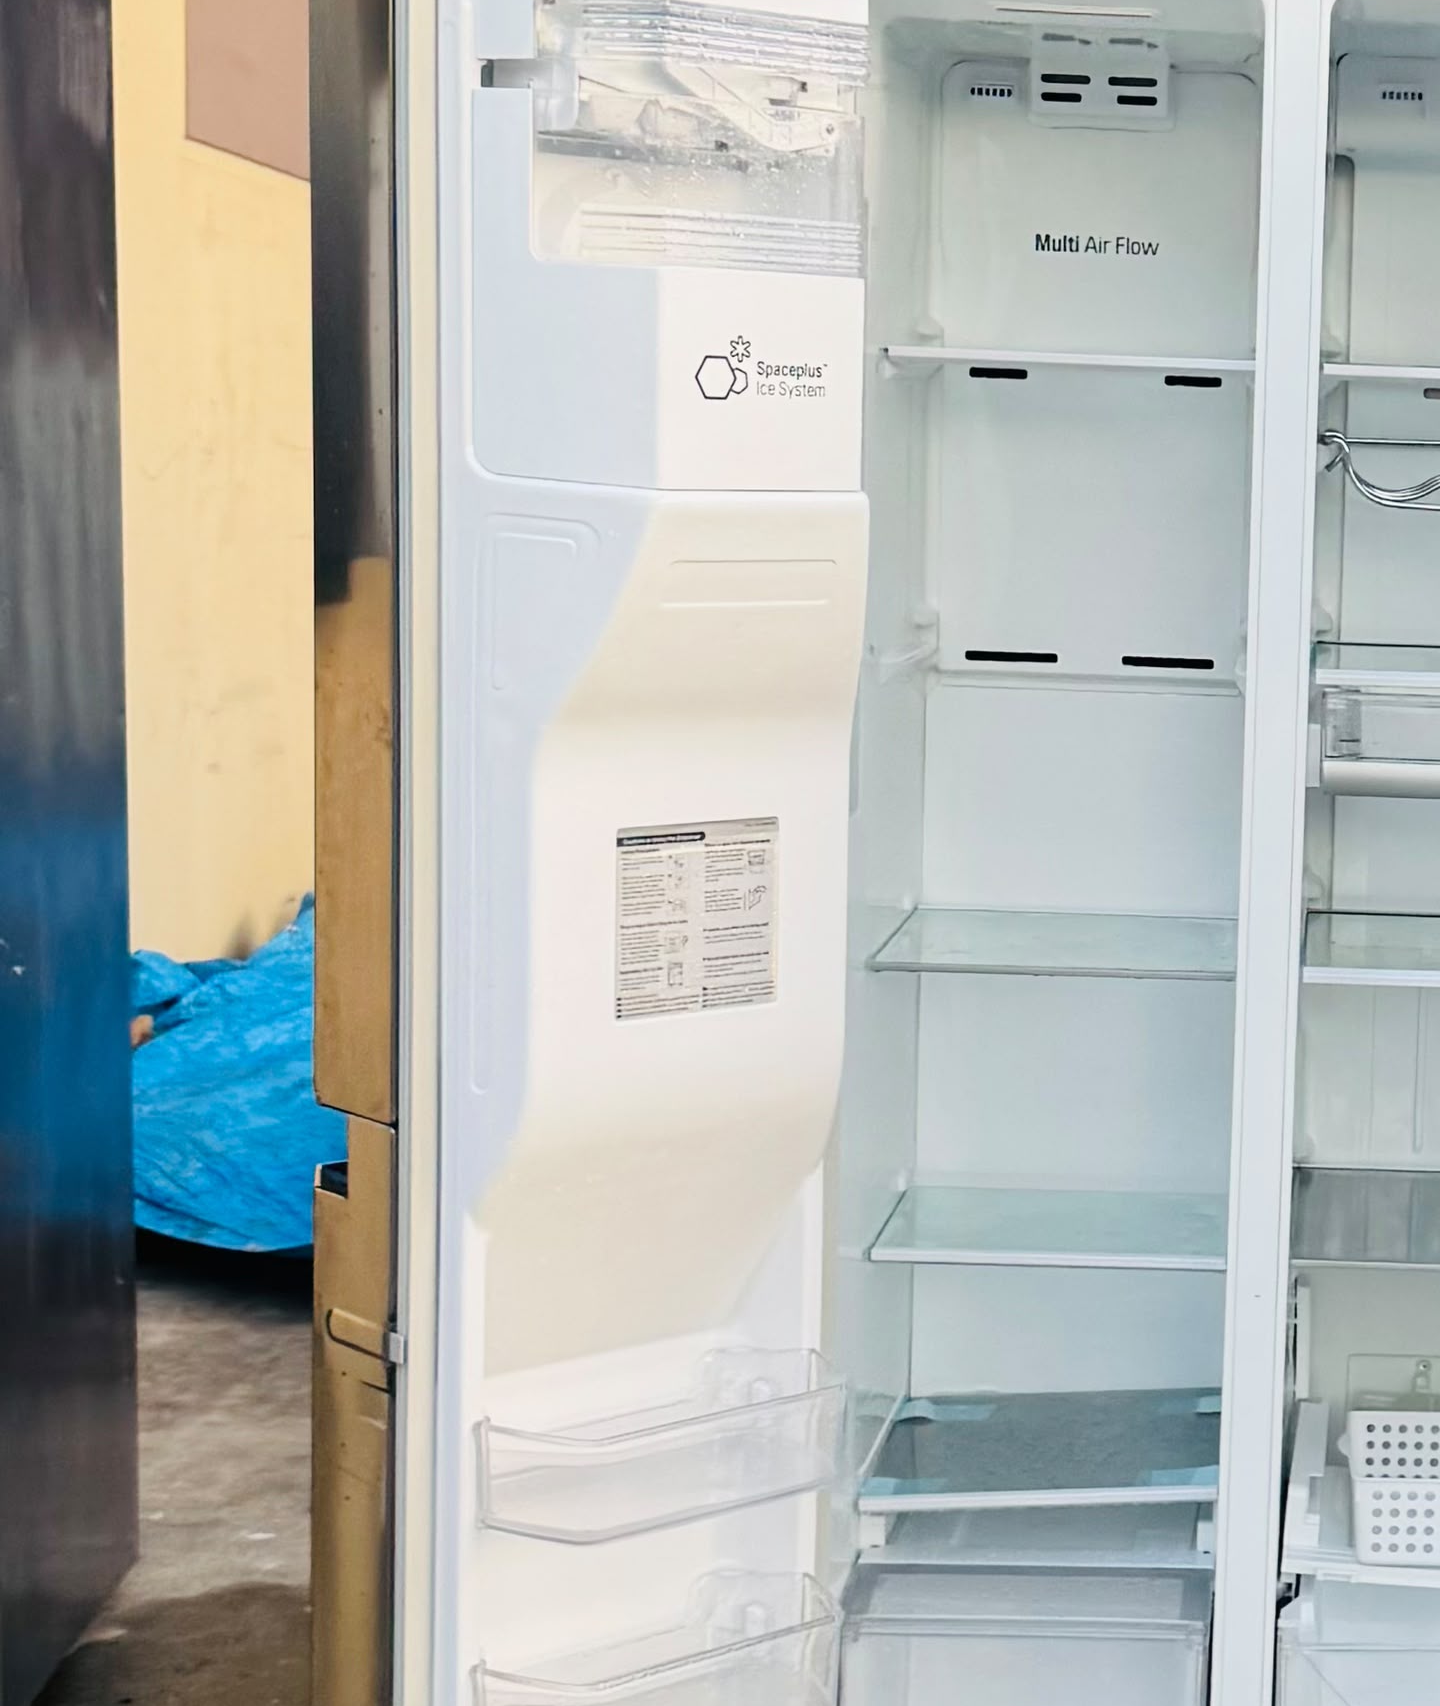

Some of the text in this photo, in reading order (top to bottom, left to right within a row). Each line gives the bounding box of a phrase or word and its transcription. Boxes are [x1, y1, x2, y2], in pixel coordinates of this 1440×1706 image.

[1035, 233, 1160, 256] Multi Air Flow
[756, 381, 826, 399] Ice System
